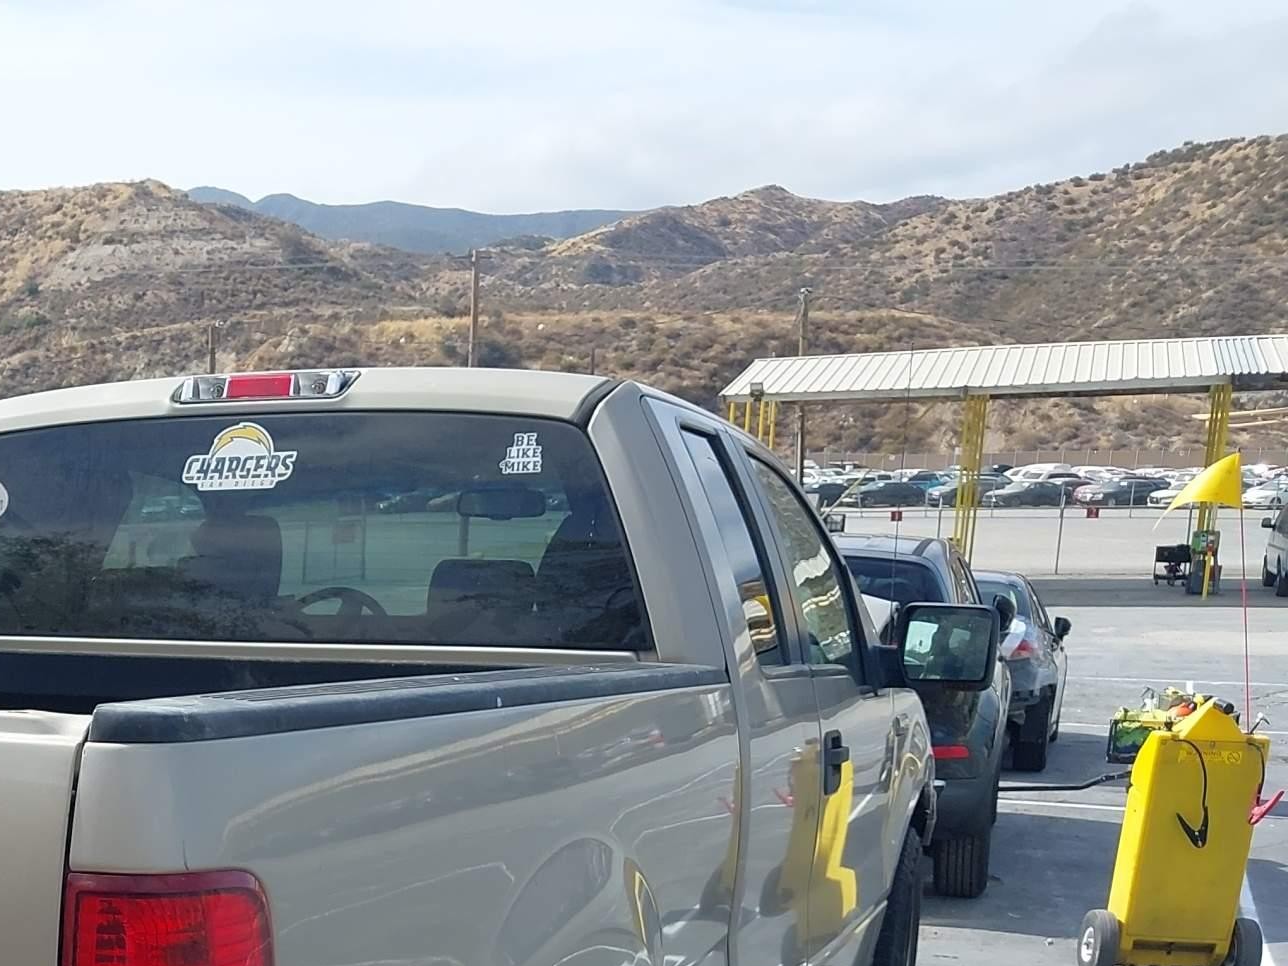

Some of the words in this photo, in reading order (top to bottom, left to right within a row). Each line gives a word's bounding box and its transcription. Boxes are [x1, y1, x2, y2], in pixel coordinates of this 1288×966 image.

[515, 434, 536, 447] BE
[508, 447, 541, 459] LIKE
[183, 453, 295, 481] CHARGERS
[500, 460, 541, 473] MIKE
